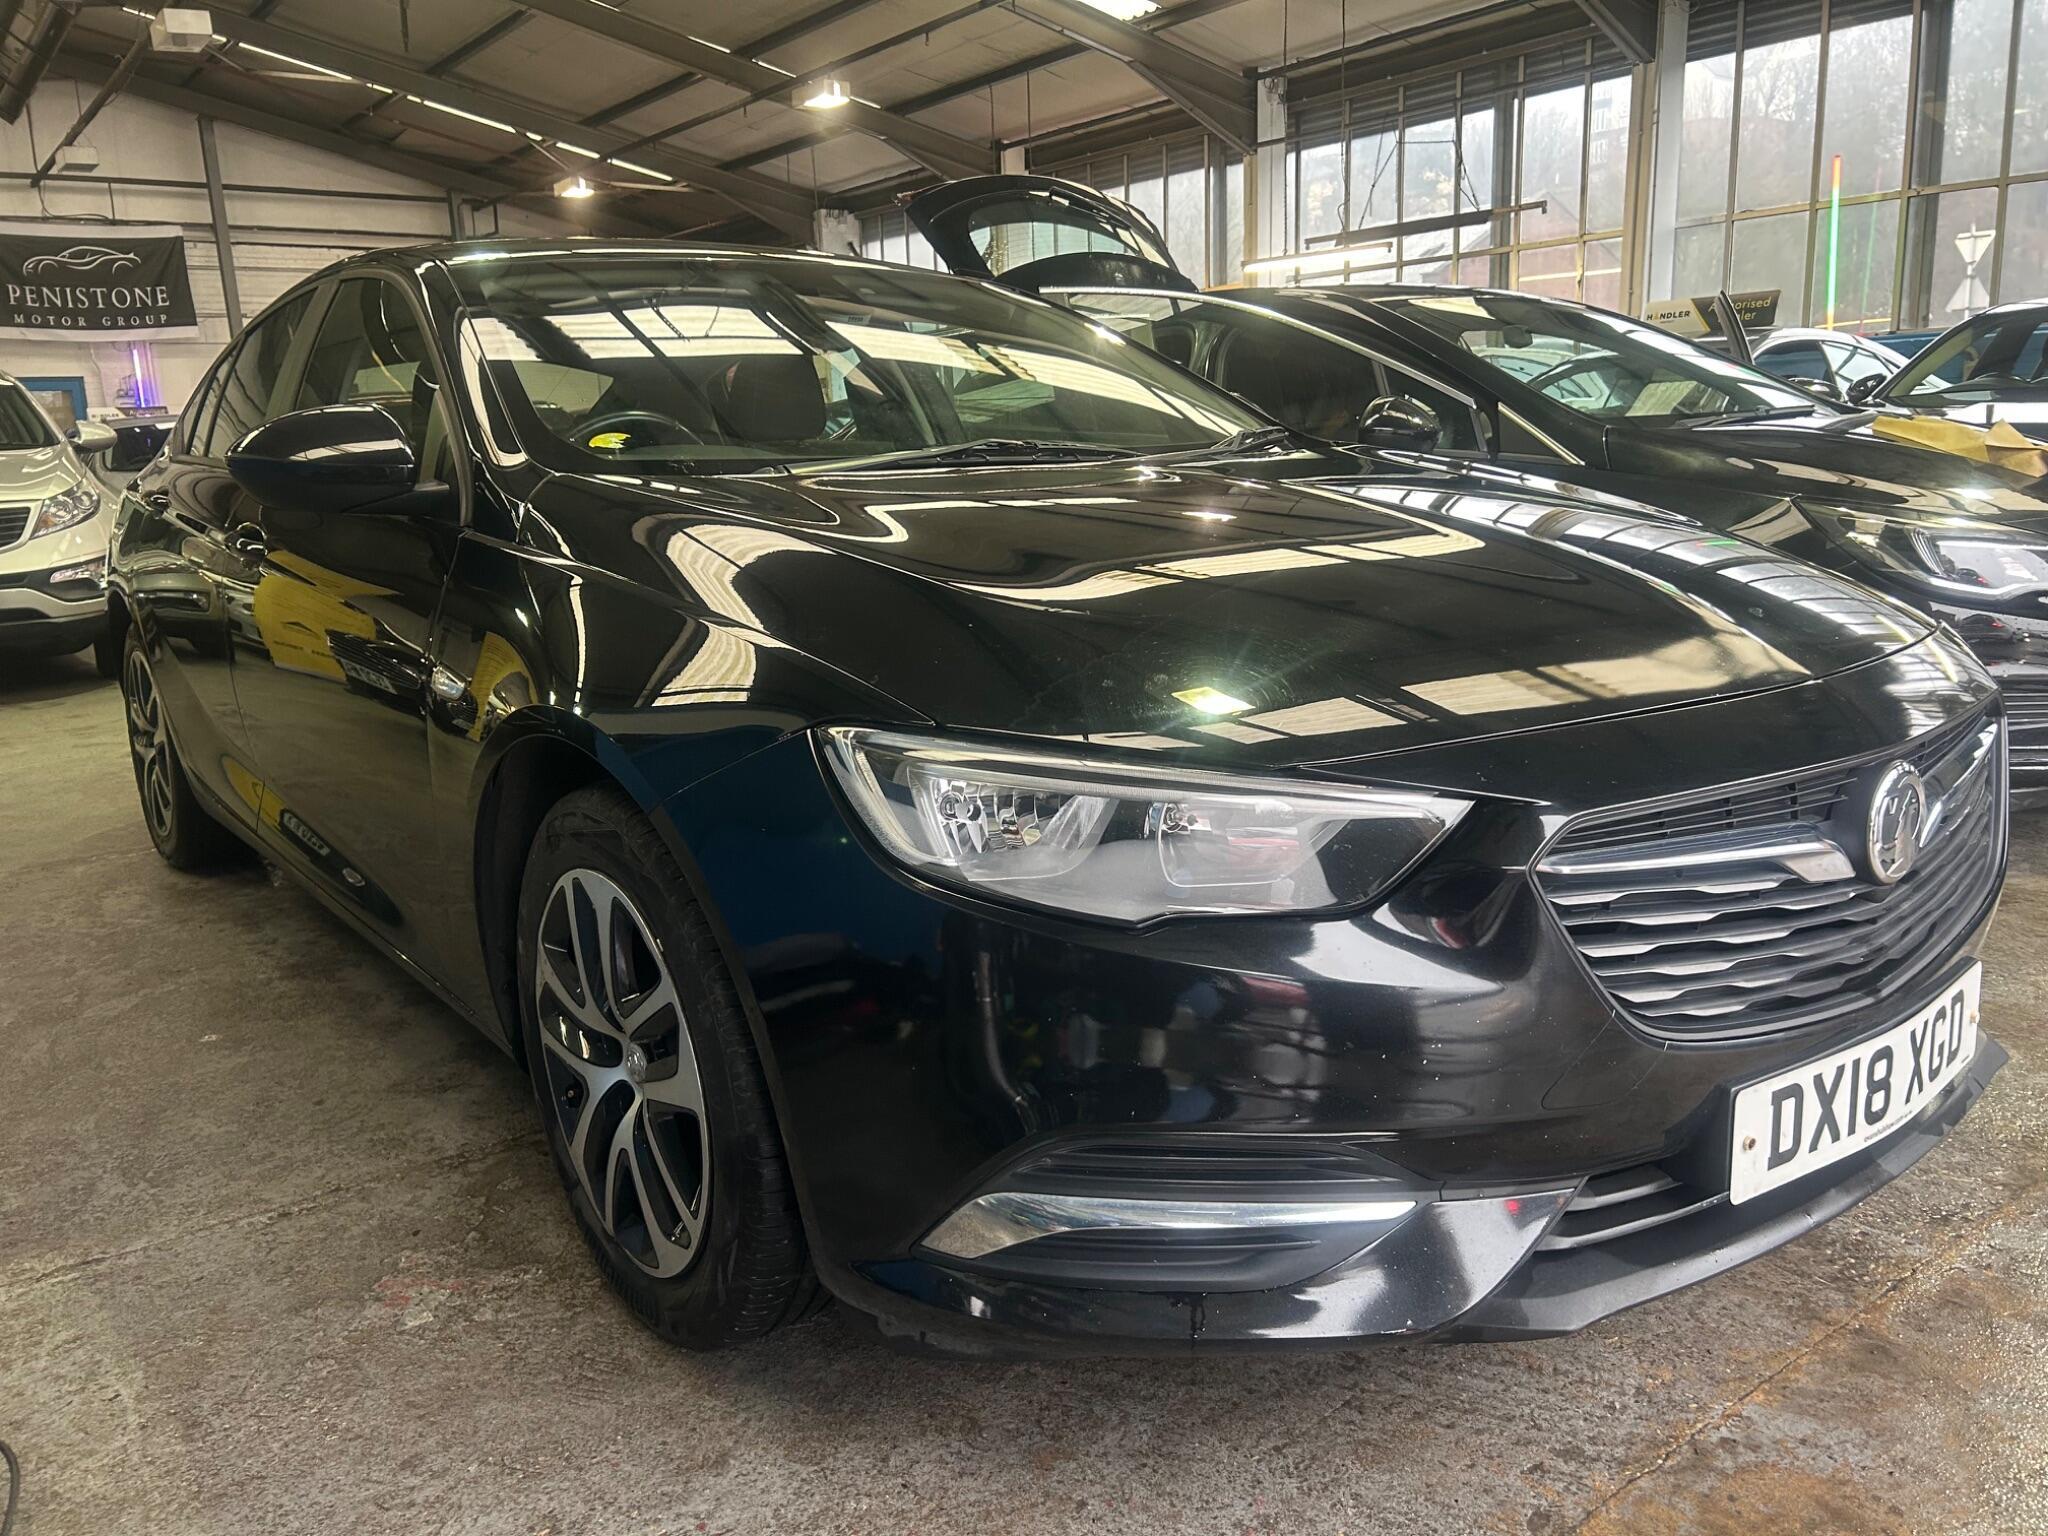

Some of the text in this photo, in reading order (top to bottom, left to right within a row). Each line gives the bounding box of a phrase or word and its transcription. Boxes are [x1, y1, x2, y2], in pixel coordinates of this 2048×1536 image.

[6, 283, 170, 308] PENISTONE
[1708, 296, 1772, 312] Aorised
[14, 313, 168, 326] MOTOR GROUP
[1767, 989, 1965, 1171] DX18 XGD
